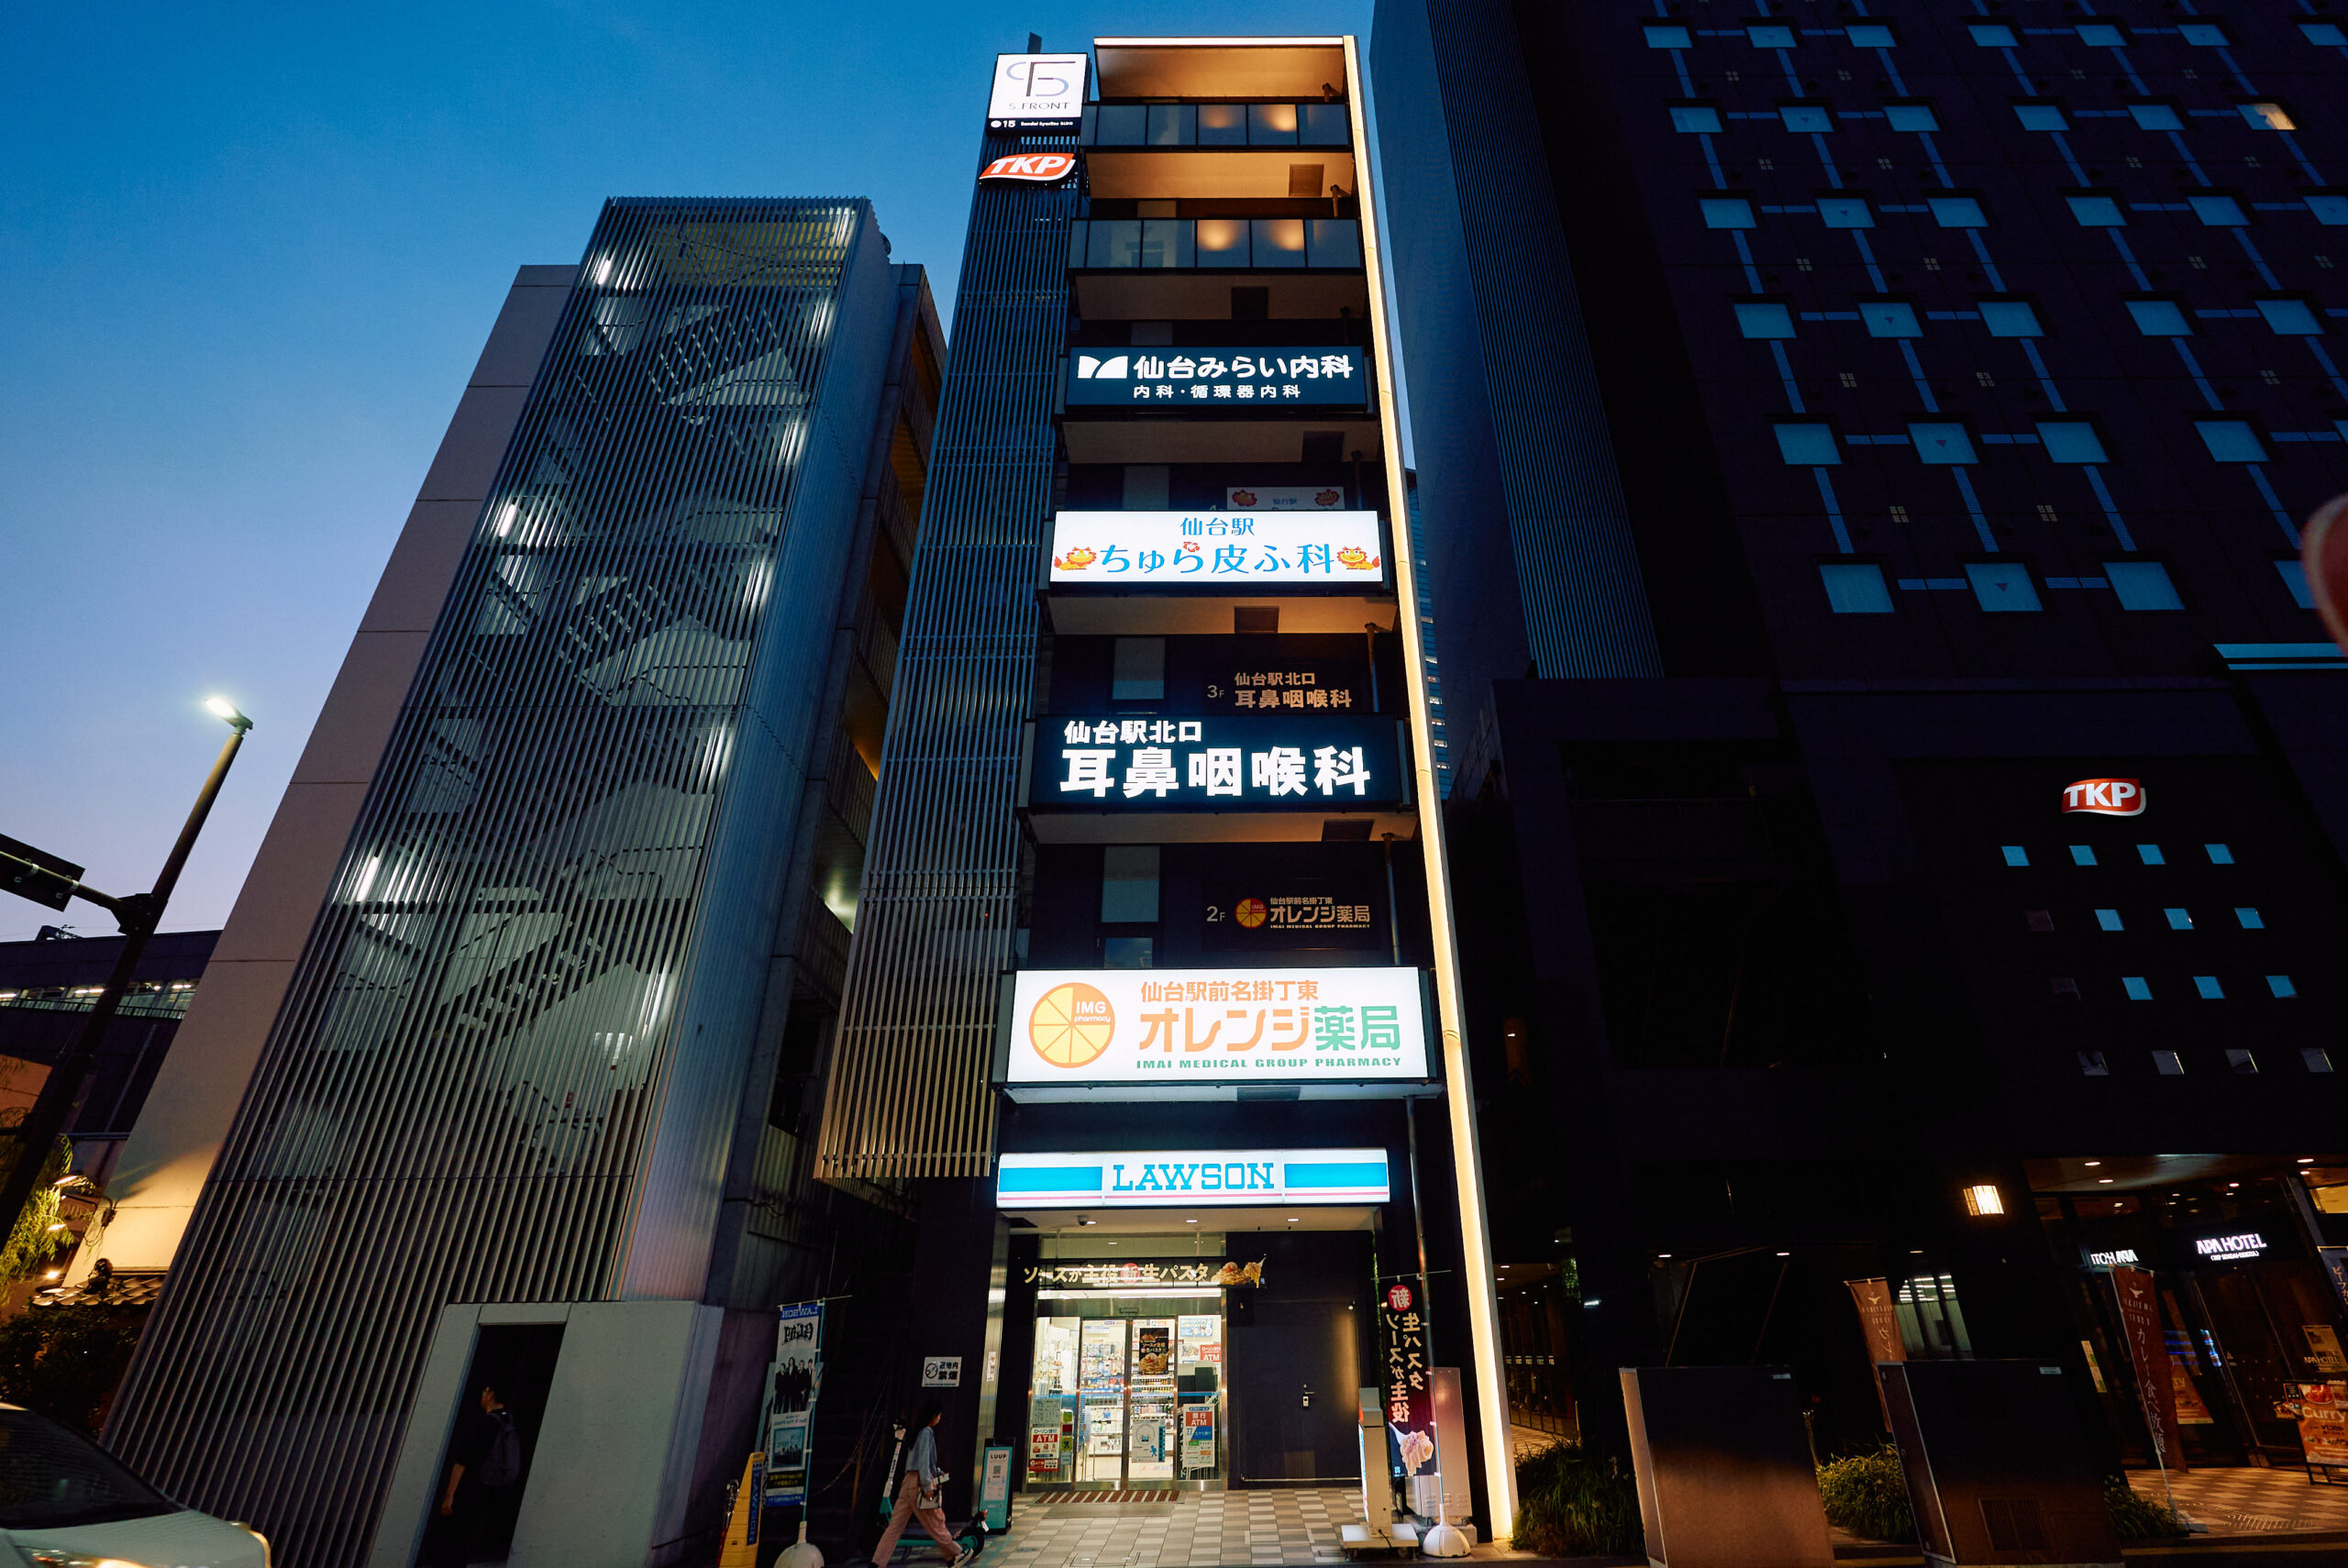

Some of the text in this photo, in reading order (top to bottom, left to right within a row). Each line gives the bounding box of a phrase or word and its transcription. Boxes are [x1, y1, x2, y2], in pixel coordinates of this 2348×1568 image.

[1021, 102, 1070, 110] FRONT
[1002, 120, 1016, 128] 15
[991, 156, 1066, 174] TKP
[1133, 355, 1354, 380] 仙台みらい内科
[1133, 385, 1301, 399] 内科・循環器内科
[1180, 517, 1255, 536] 仙台駅
[1101, 543, 1335, 574] ちゅら皮ふ科
[1235, 672, 1316, 686] 仙台駅北口
[1207, 685, 1225, 699] 3F
[1235, 690, 1352, 709] 耳鼻咽喉科
[1064, 721, 1202, 744] 仙台駅北口
[1059, 745, 1370, 799] 耳鼻咽喉科
[2063, 781, 2136, 807] TKP
[1206, 906, 1225, 922] 2F
[1270, 905, 1370, 923] オレンジ薬局
[1141, 980, 1319, 1002] 仙台駅前名掛丁東
[1076, 1001, 1106, 1014] IMG
[1074, 1014, 1111, 1023] pharmacy
[1139, 1005, 1401, 1053] オレンジ薬局
[1136, 1057, 1401, 1069] IMAI MEDICAL GROUP PHARMACY
[1113, 1163, 1275, 1191] LAWSON
[2196, 1233, 2267, 1254] APA HOTEL
[2302, 1406, 2345, 1422] Curry
